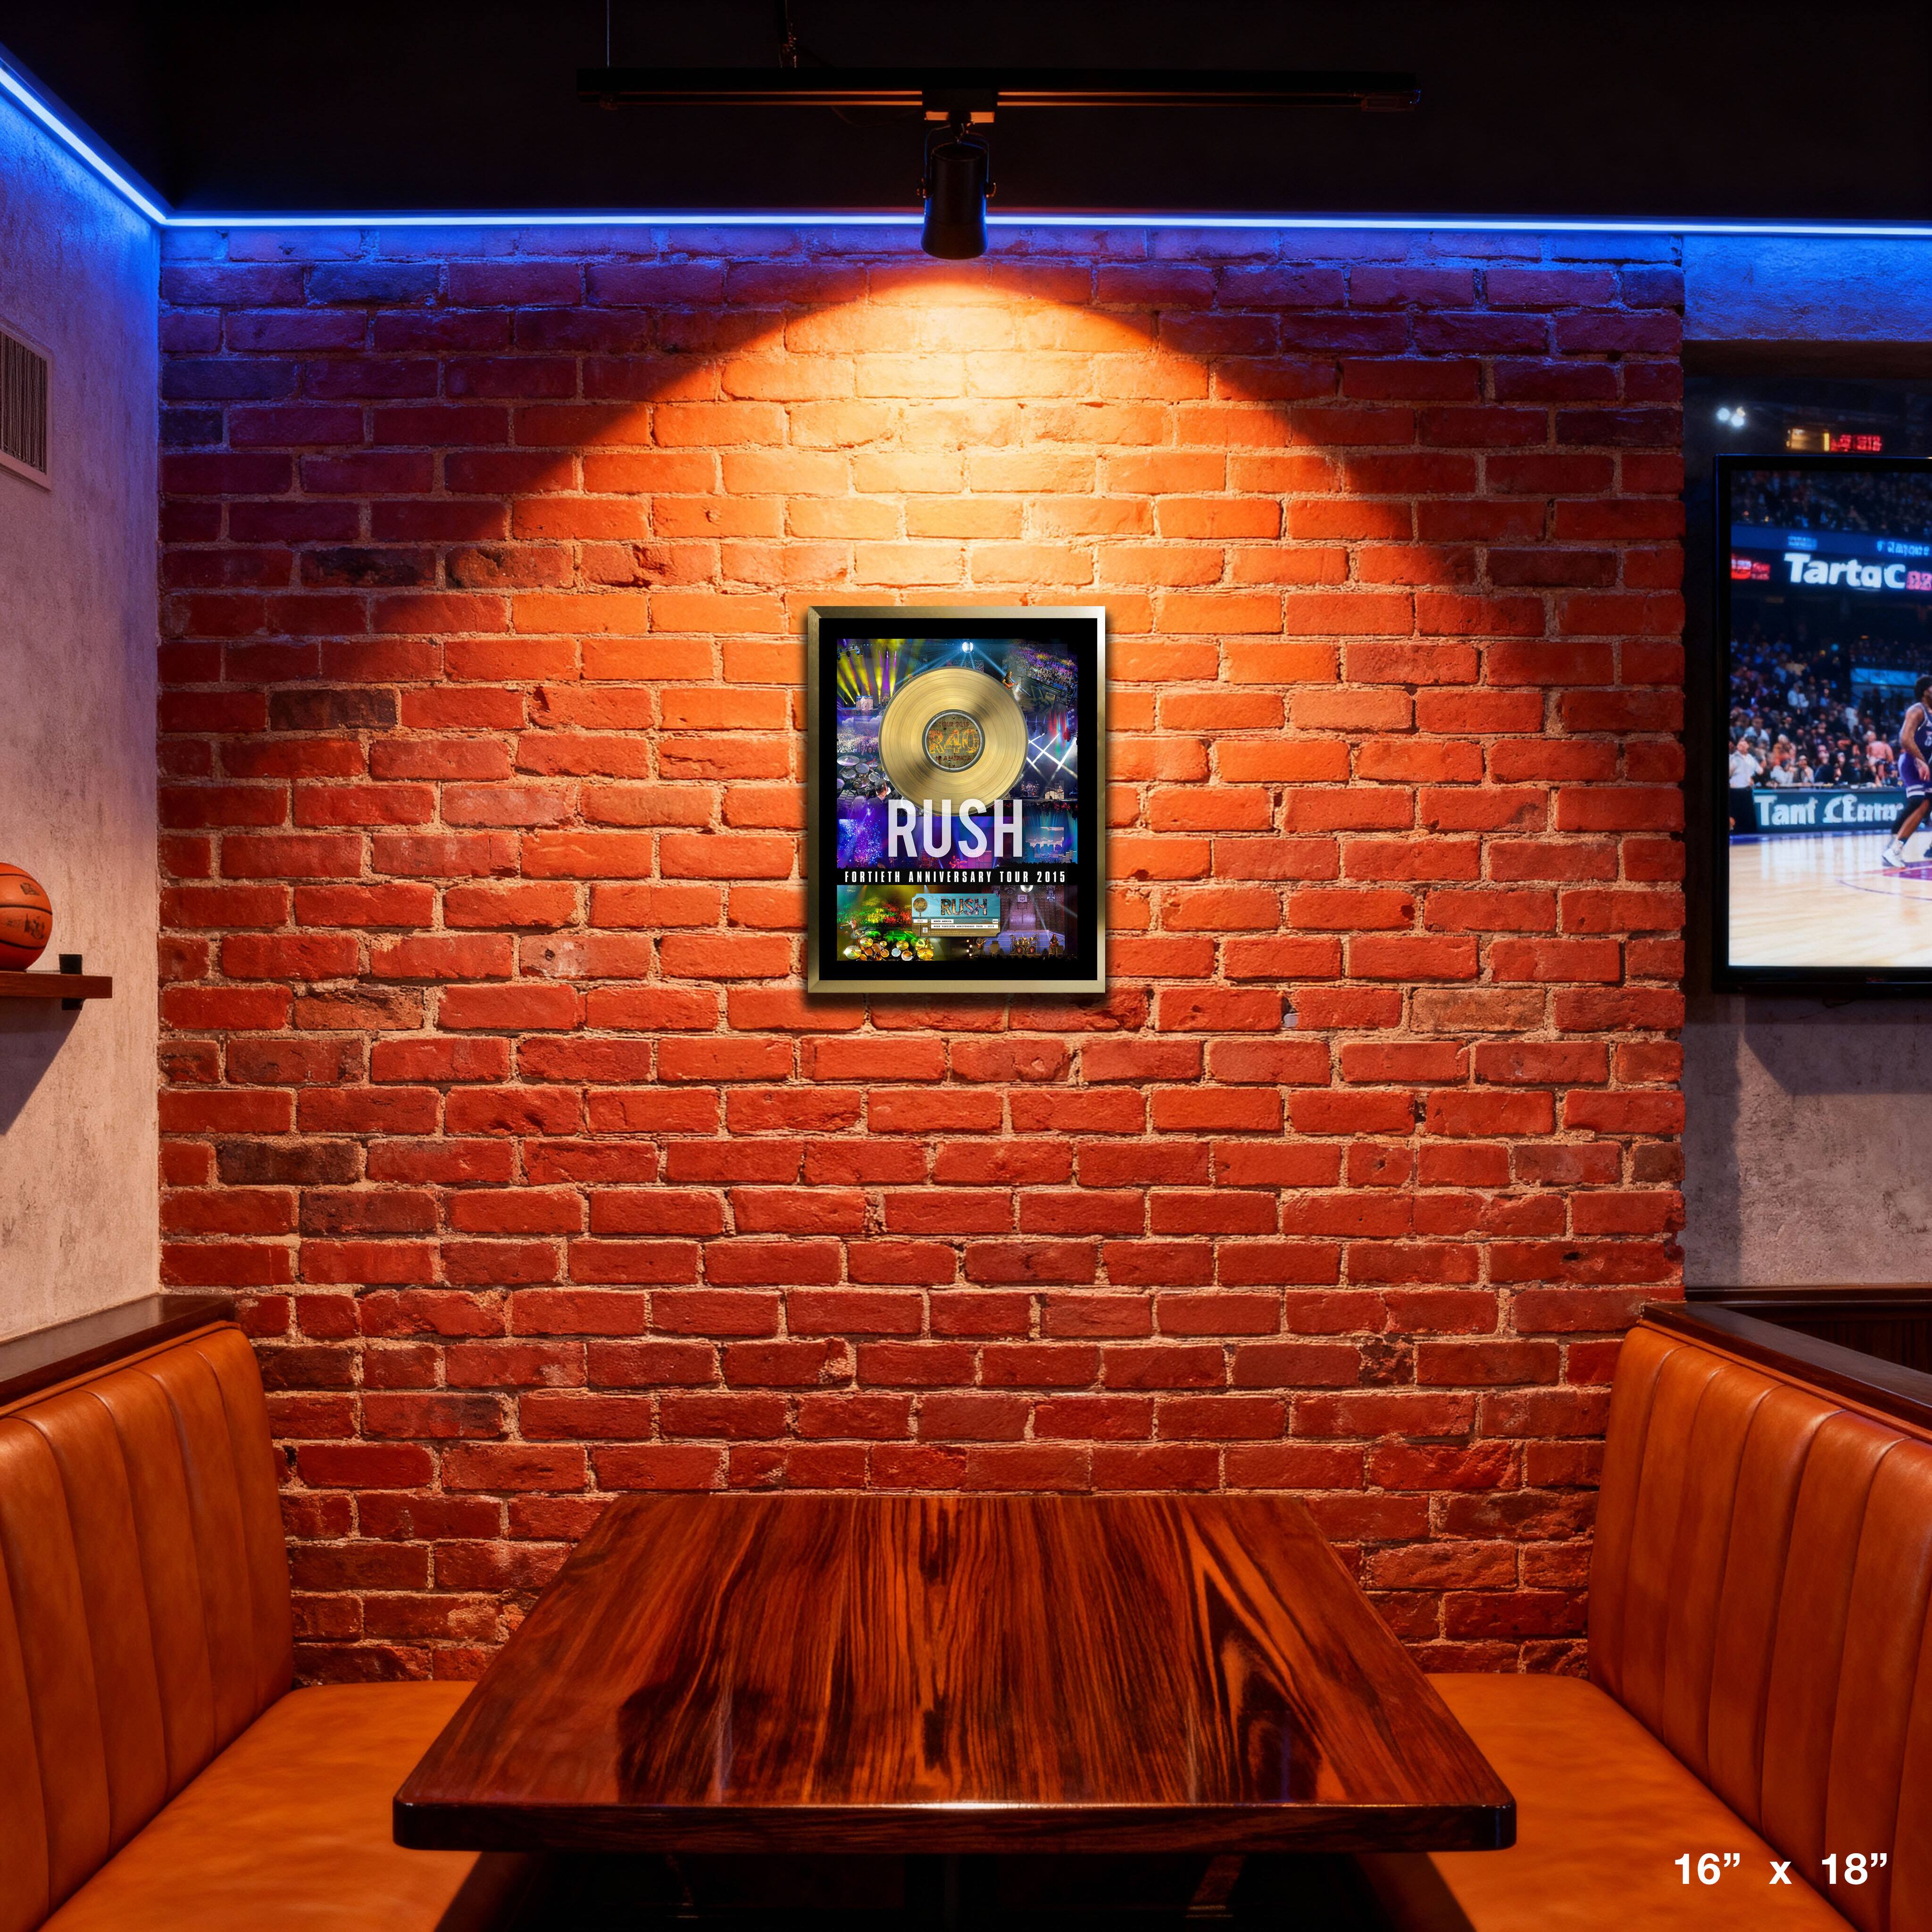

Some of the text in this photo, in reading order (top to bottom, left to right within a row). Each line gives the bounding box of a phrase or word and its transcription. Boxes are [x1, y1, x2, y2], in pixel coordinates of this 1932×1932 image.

[929, 728, 980, 754] R40
[888, 799, 1023, 858] RUSH
[845, 871, 1066, 883] FORTIETH ANNIVERSARY TOUR 2015
[941, 898, 987, 916] RUSH
